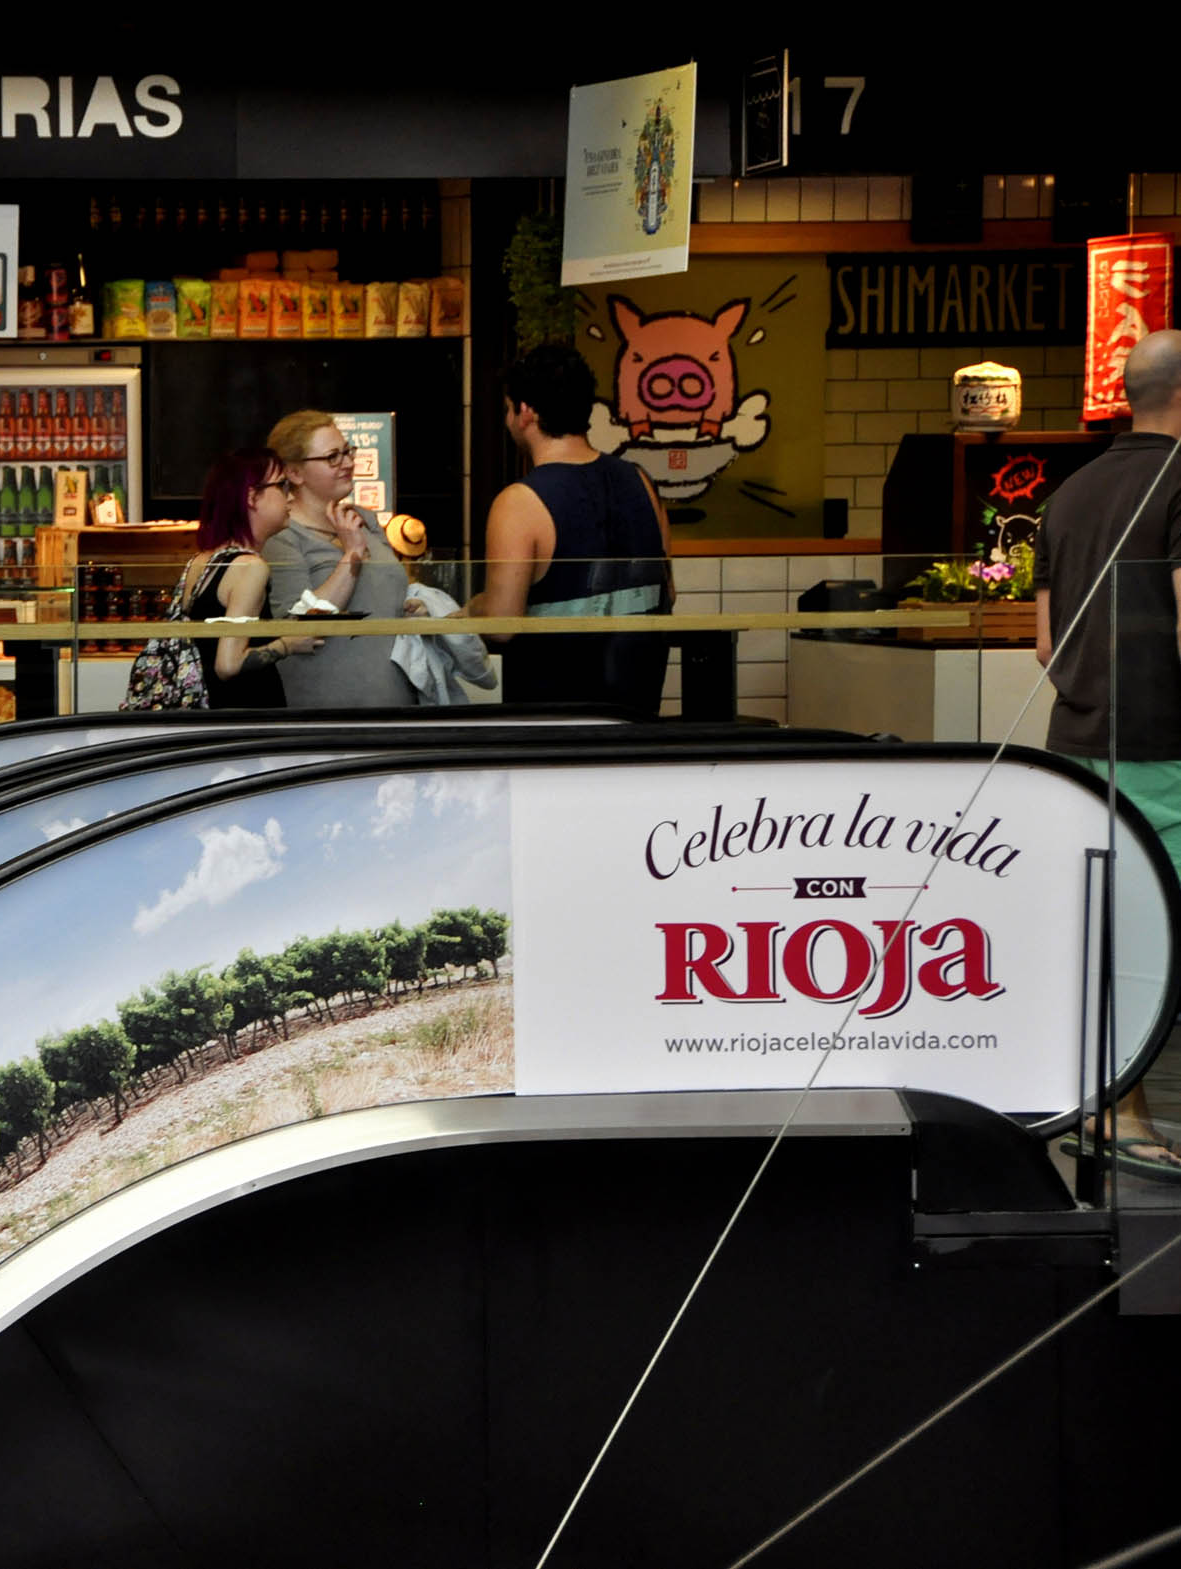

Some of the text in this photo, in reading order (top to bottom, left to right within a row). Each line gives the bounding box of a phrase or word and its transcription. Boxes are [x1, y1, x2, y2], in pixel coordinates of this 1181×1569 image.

[828, 263, 1075, 335] SHIMARKET
[1004, 464, 1035, 489] NEW
[644, 792, 1022, 881] Celebra la vida
[805, 879, 855, 897] CON
[664, 1031, 999, 1056] www.riojacelebralavida.com
